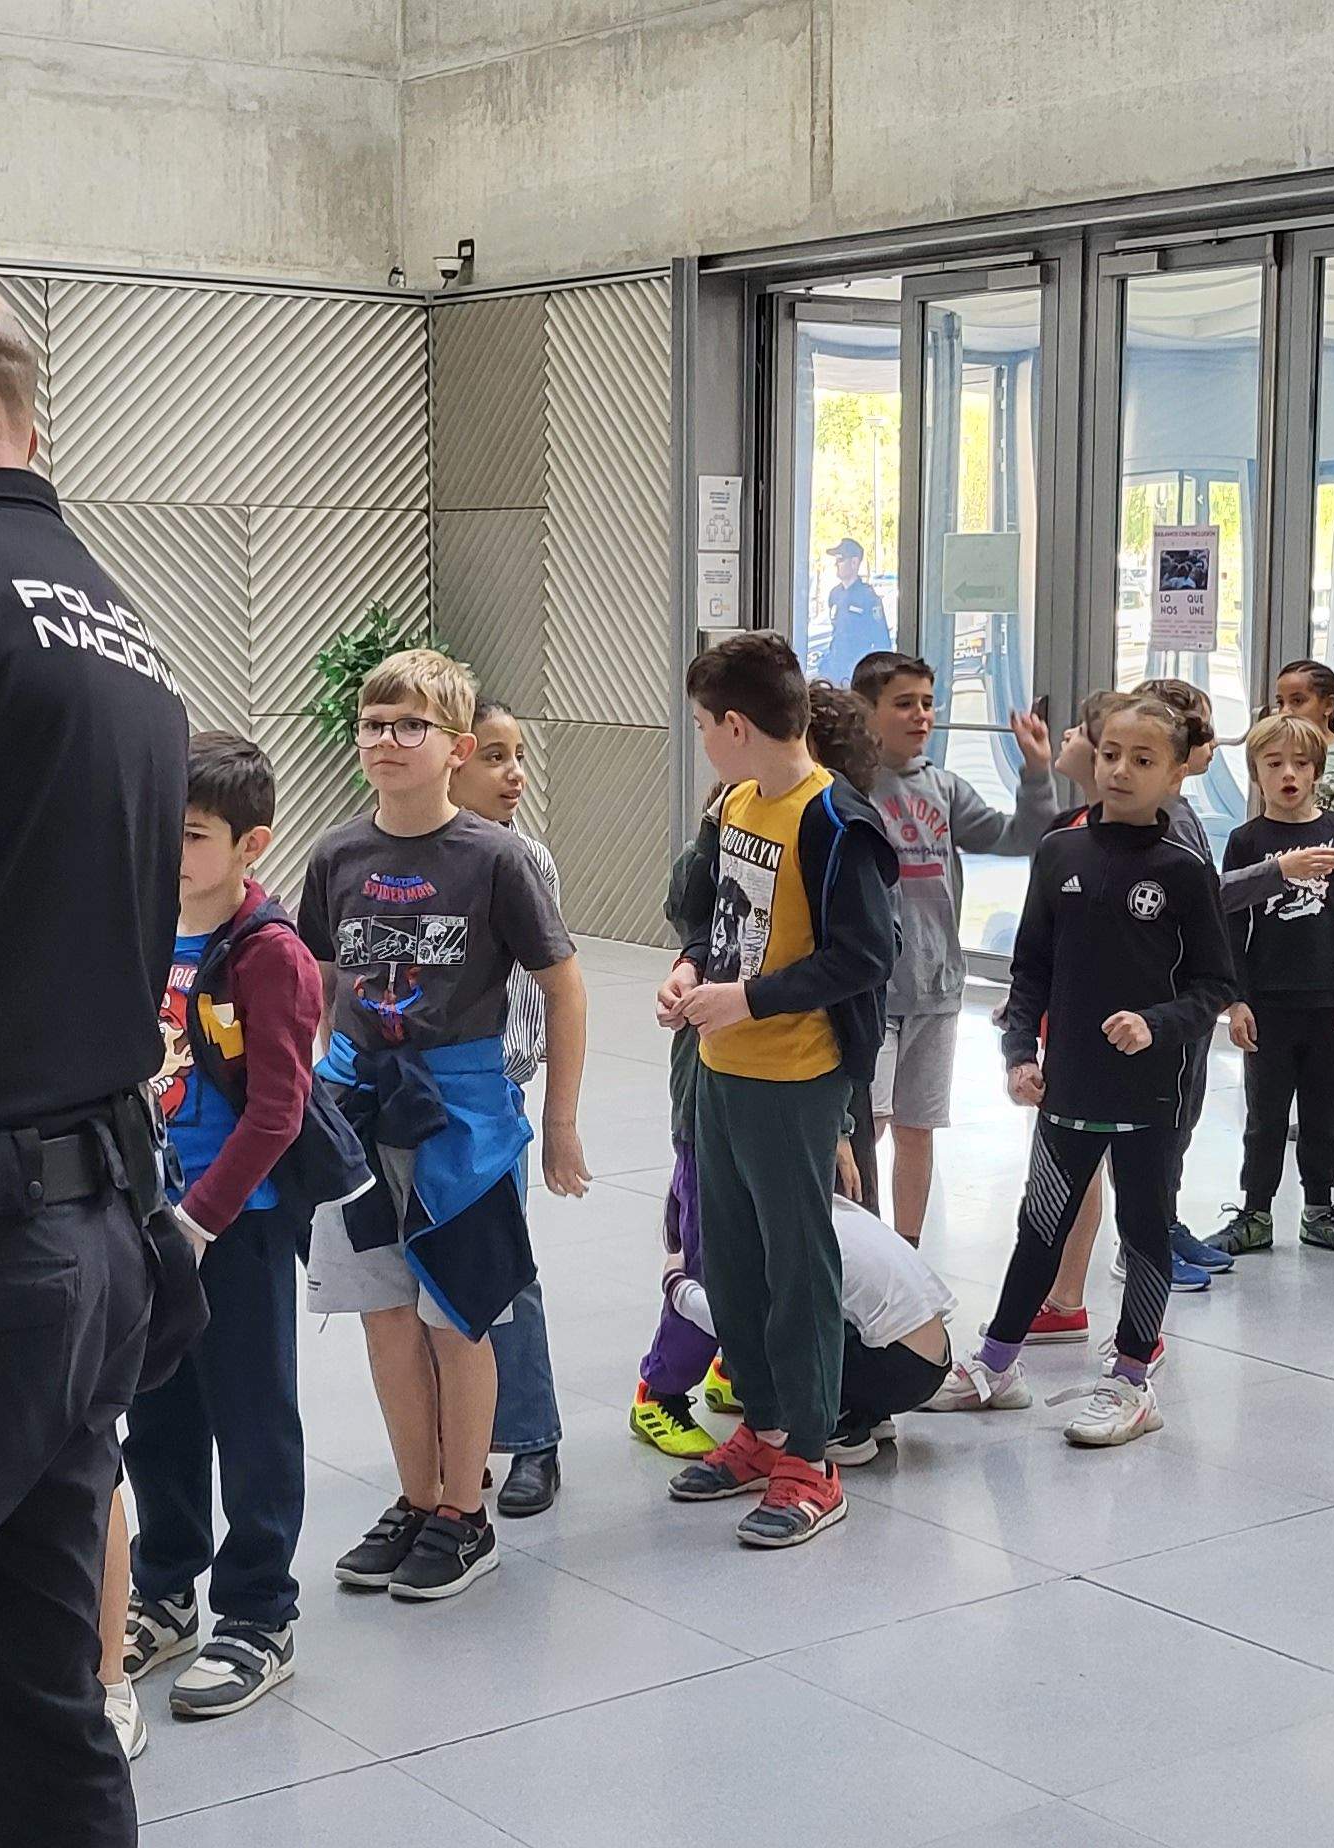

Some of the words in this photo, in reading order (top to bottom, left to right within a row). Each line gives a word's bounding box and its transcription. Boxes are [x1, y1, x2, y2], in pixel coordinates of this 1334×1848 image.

[1160, 594, 1171, 604] LO
[1187, 594, 1204, 604] QUE
[1160, 606, 1178, 615] NOS
[1189, 606, 1204, 616] UNE
[167, 965, 198, 988] RIO
